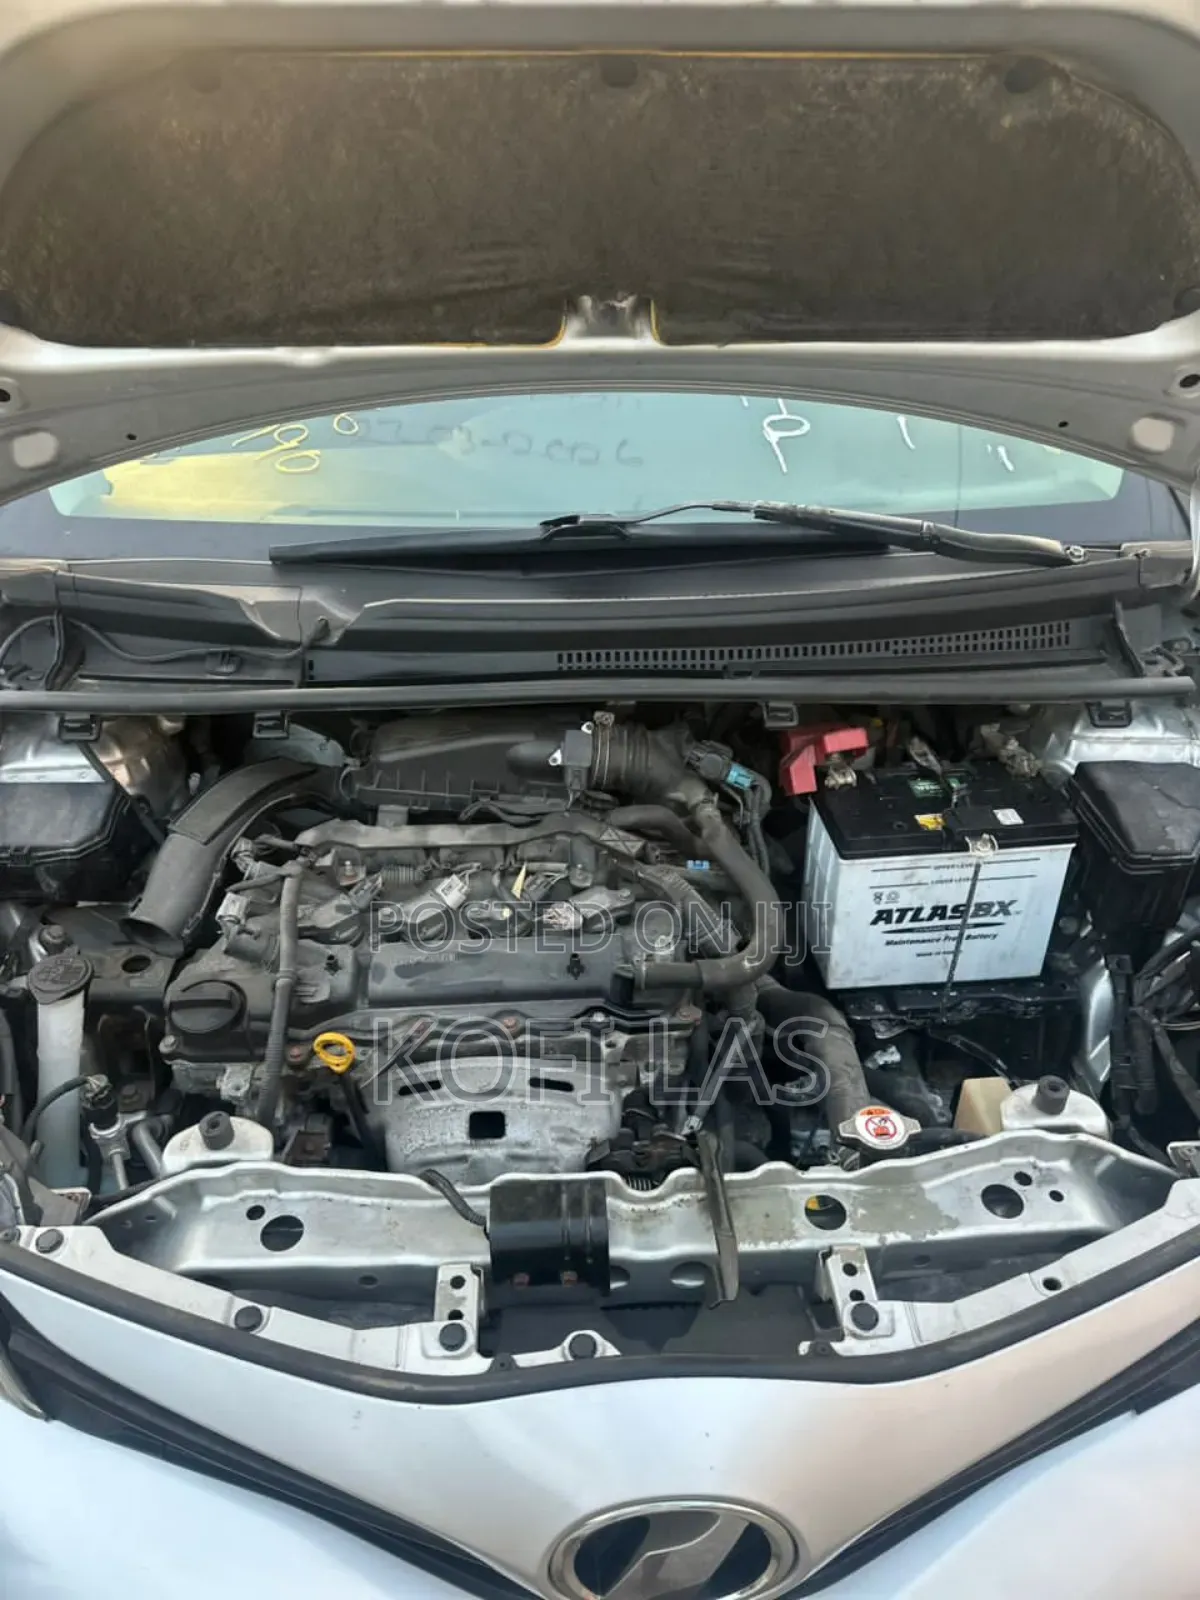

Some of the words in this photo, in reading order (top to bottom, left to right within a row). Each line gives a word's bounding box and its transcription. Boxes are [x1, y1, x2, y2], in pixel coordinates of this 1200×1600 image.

[869, 900, 1018, 926] ATLASBX
[884, 936, 940, 946] Maintenance
[943, 934, 962, 943] Fre
[965, 932, 998, 941] Battery
